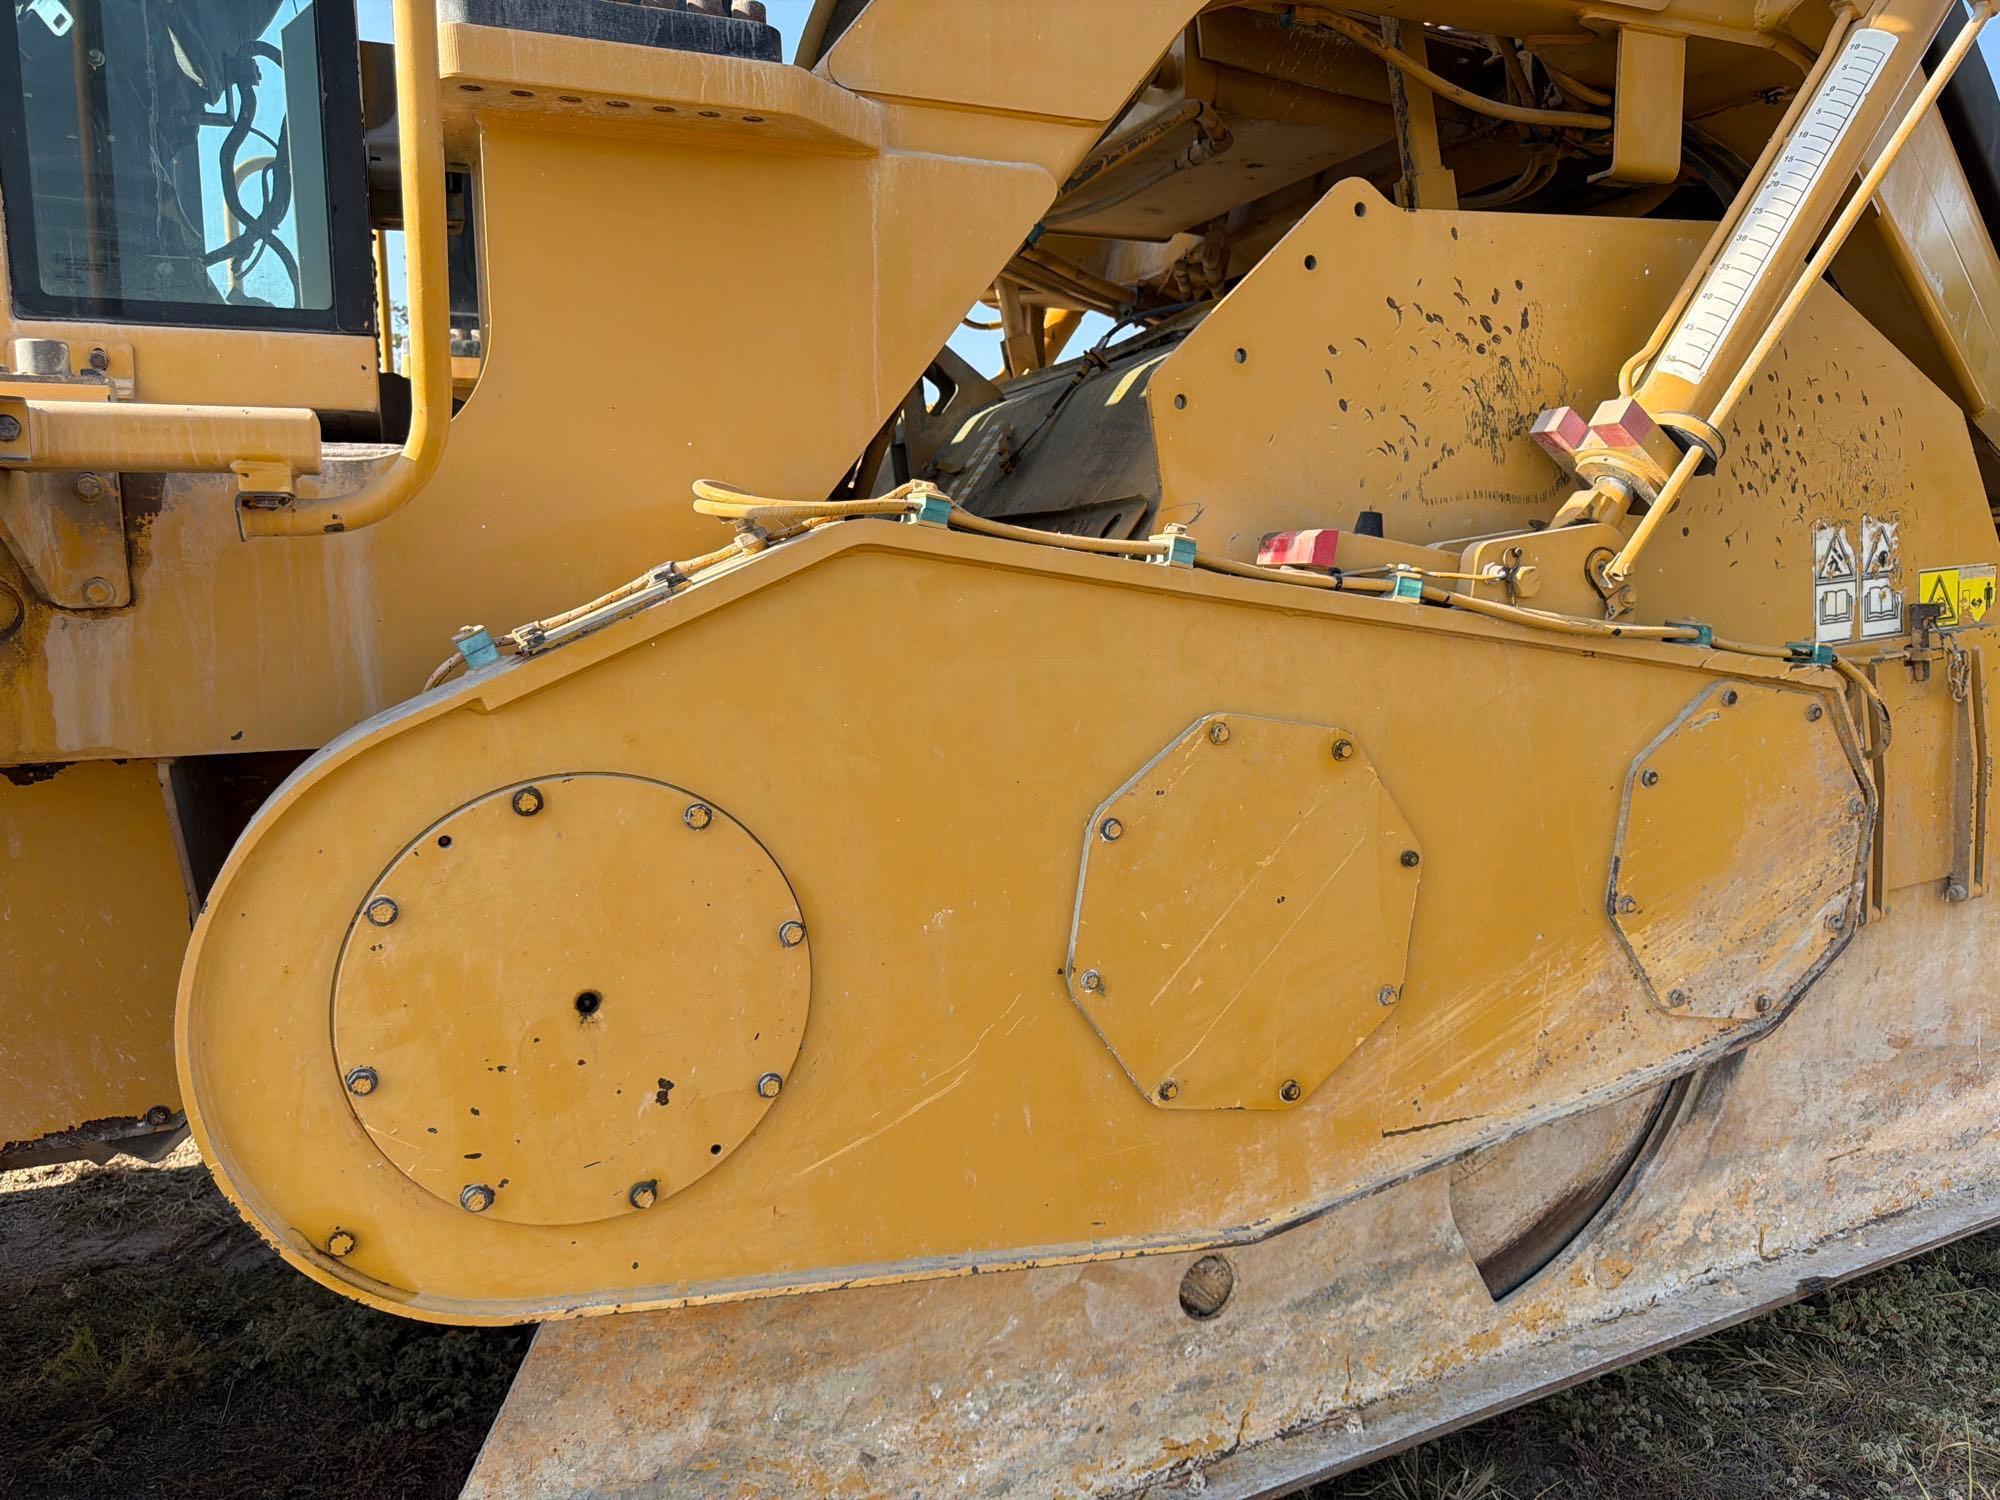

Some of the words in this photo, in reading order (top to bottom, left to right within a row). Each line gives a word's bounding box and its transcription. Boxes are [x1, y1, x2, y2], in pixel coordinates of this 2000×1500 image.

[1768, 180, 1780, 188] 20
[1736, 234, 1748, 242] 30
[1702, 292, 1713, 300] 40
[1665, 354, 1676, 362] 50
